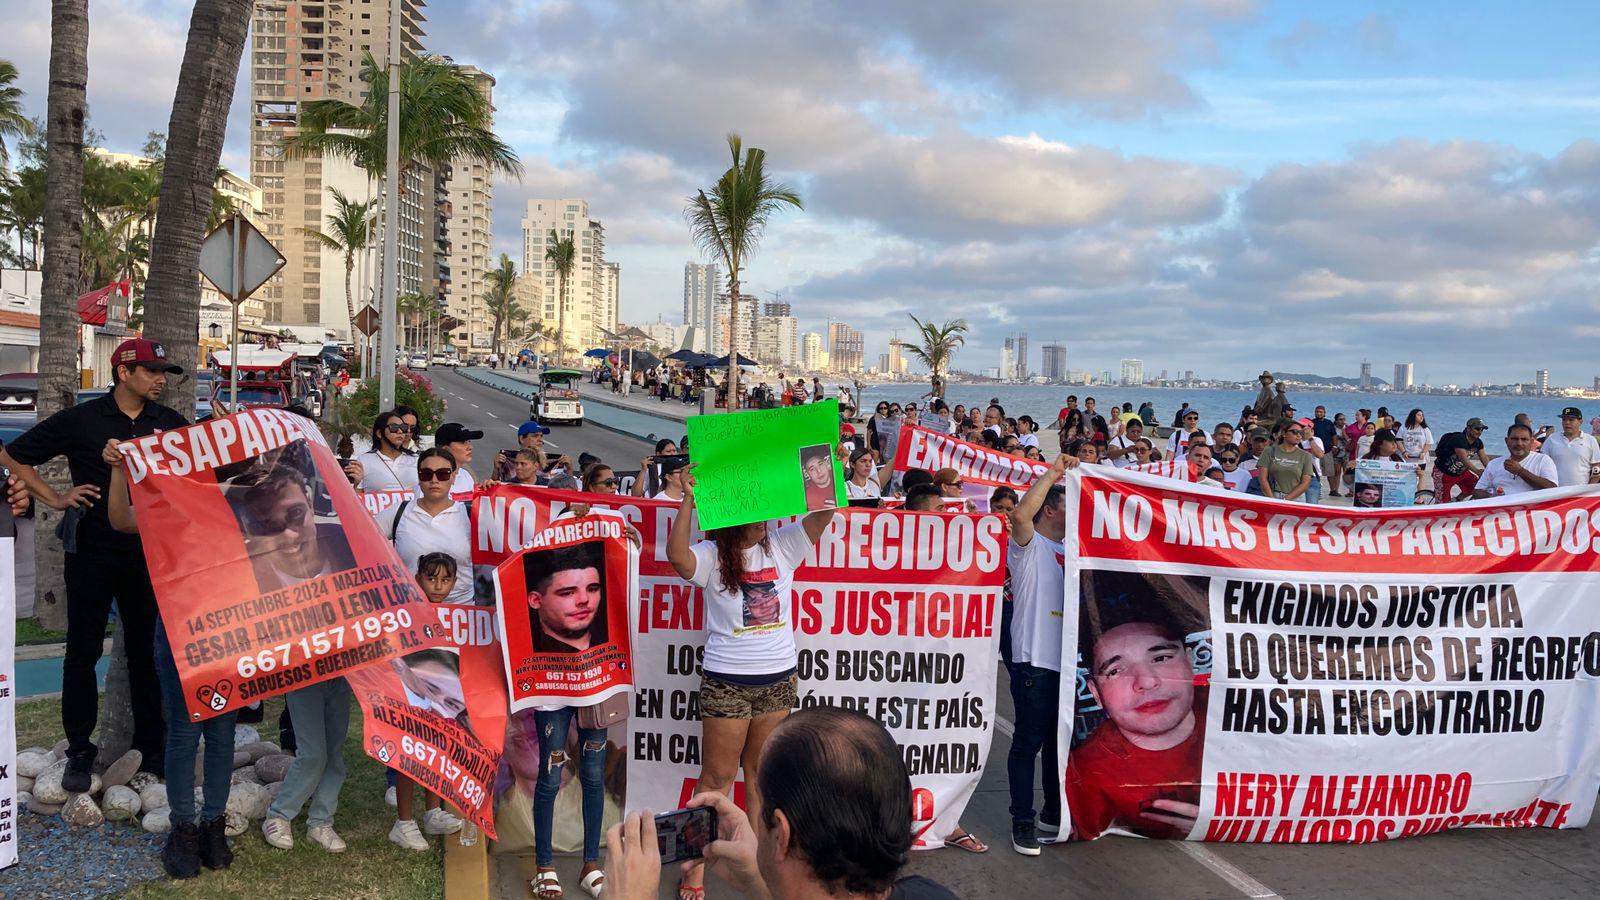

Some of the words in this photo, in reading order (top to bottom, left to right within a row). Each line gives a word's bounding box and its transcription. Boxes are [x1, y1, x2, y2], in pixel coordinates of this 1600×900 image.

[478, 496, 536, 554] NO
[1091, 490, 1153, 542] NO
[1161, 498, 1257, 551] MAS
[186, 617, 206, 636] 14
[206, 593, 293, 630] SEPTIEMBRE
[293, 581, 328, 602] 2024
[334, 563, 393, 592] MAZATLÁN
[831, 591, 995, 638] JUSTICIA!
[1224, 579, 1379, 629] EXIGIMOS
[1382, 583, 1524, 629] JUSTICIA
[185, 630, 251, 667] CESAR
[254, 602, 337, 646] ANTONIO
[339, 587, 385, 619] LEON
[237, 643, 291, 678] 667
[298, 626, 345, 660] 157
[351, 608, 412, 643] 1930
[239, 664, 312, 700] SABUESOS
[546, 672, 564, 681] 667
[566, 672, 582, 681] 157
[584, 666, 603, 680] 1930
[836, 650, 965, 684] BUSCANDO
[1226, 633, 1260, 680] LO
[1267, 633, 1434, 685] QUEREMOS
[1442, 636, 1483, 682] DE
[535, 682, 569, 690] SABUESOS
[635, 688, 663, 719] EN
[876, 696, 929, 730] ESTE
[934, 691, 988, 731] PAÍS,
[1222, 688, 1326, 735] HASTA
[1334, 688, 1545, 737] ENCONTRARLO
[373, 705, 447, 750] ALEJANDRO
[449, 738, 490, 784] TRUJILLO
[634, 732, 662, 761] EN
[400, 754, 441, 790] SABUESOS
[401, 735, 437, 766] 667
[440, 755, 462, 782] 157
[458, 776, 486, 810] 1930
[1214, 771, 1299, 818] NERY
[1302, 771, 1473, 817] ALEJANDRO
